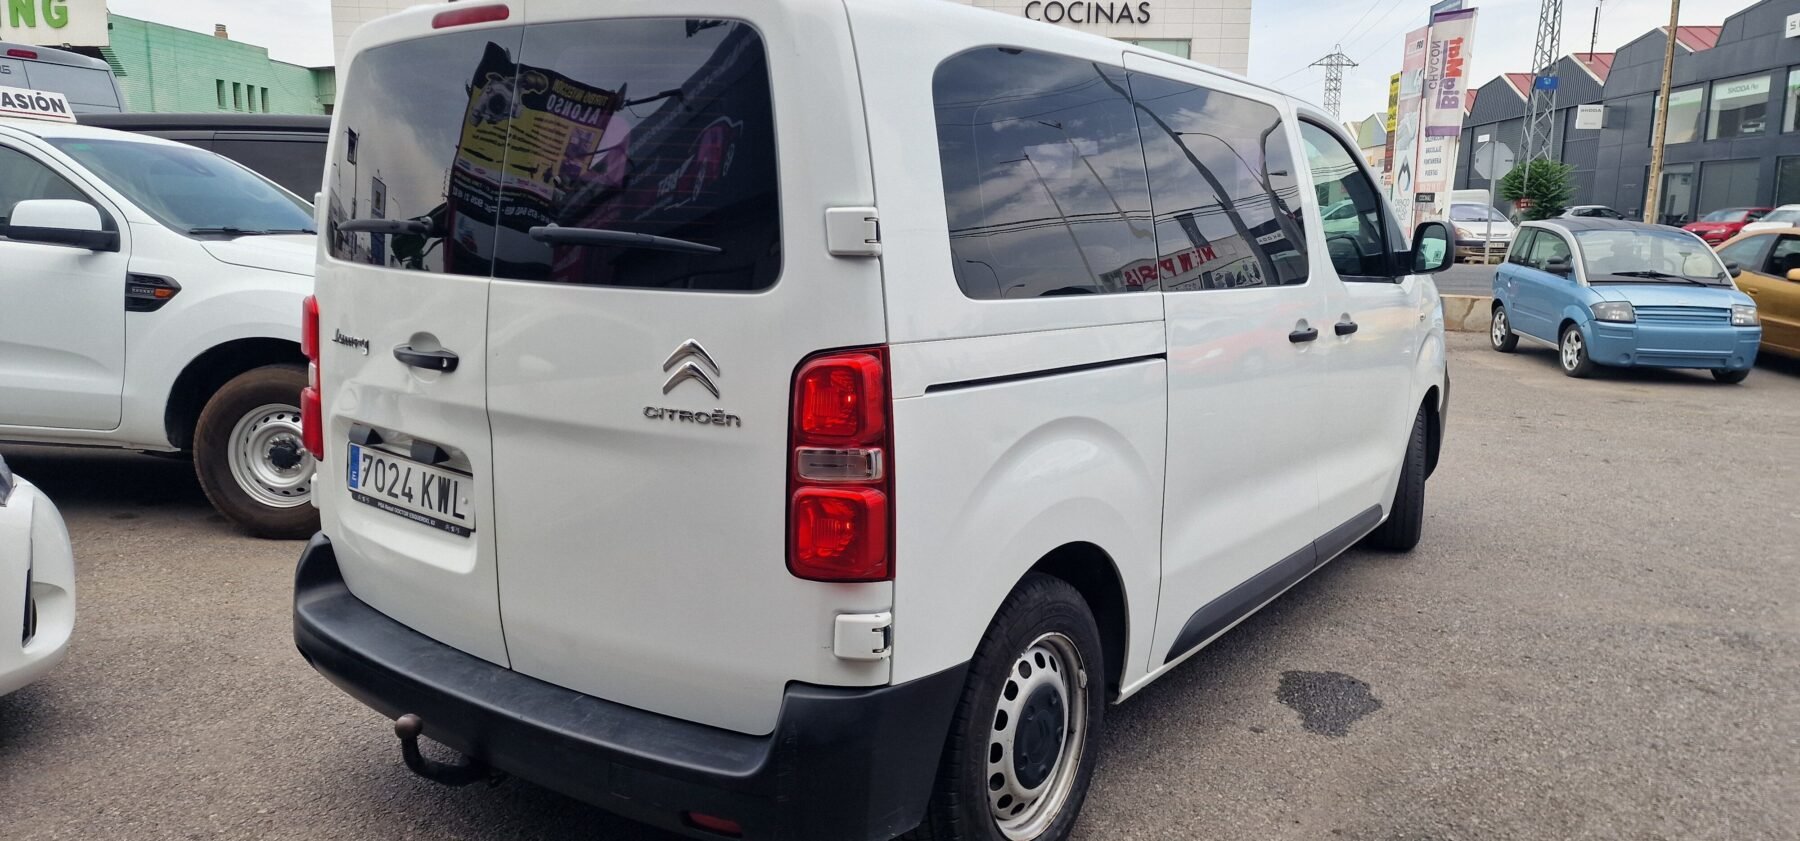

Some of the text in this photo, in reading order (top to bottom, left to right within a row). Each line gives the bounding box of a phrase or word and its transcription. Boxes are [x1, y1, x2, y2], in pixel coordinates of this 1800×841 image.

[0, 0, 68, 28] NG
[1025, 1, 1151, 24] COCINAS
[332, 328, 370, 356] Jumpy
[643, 406, 742, 428] CITROËN
[362, 453, 465, 520] 7024 KWL
